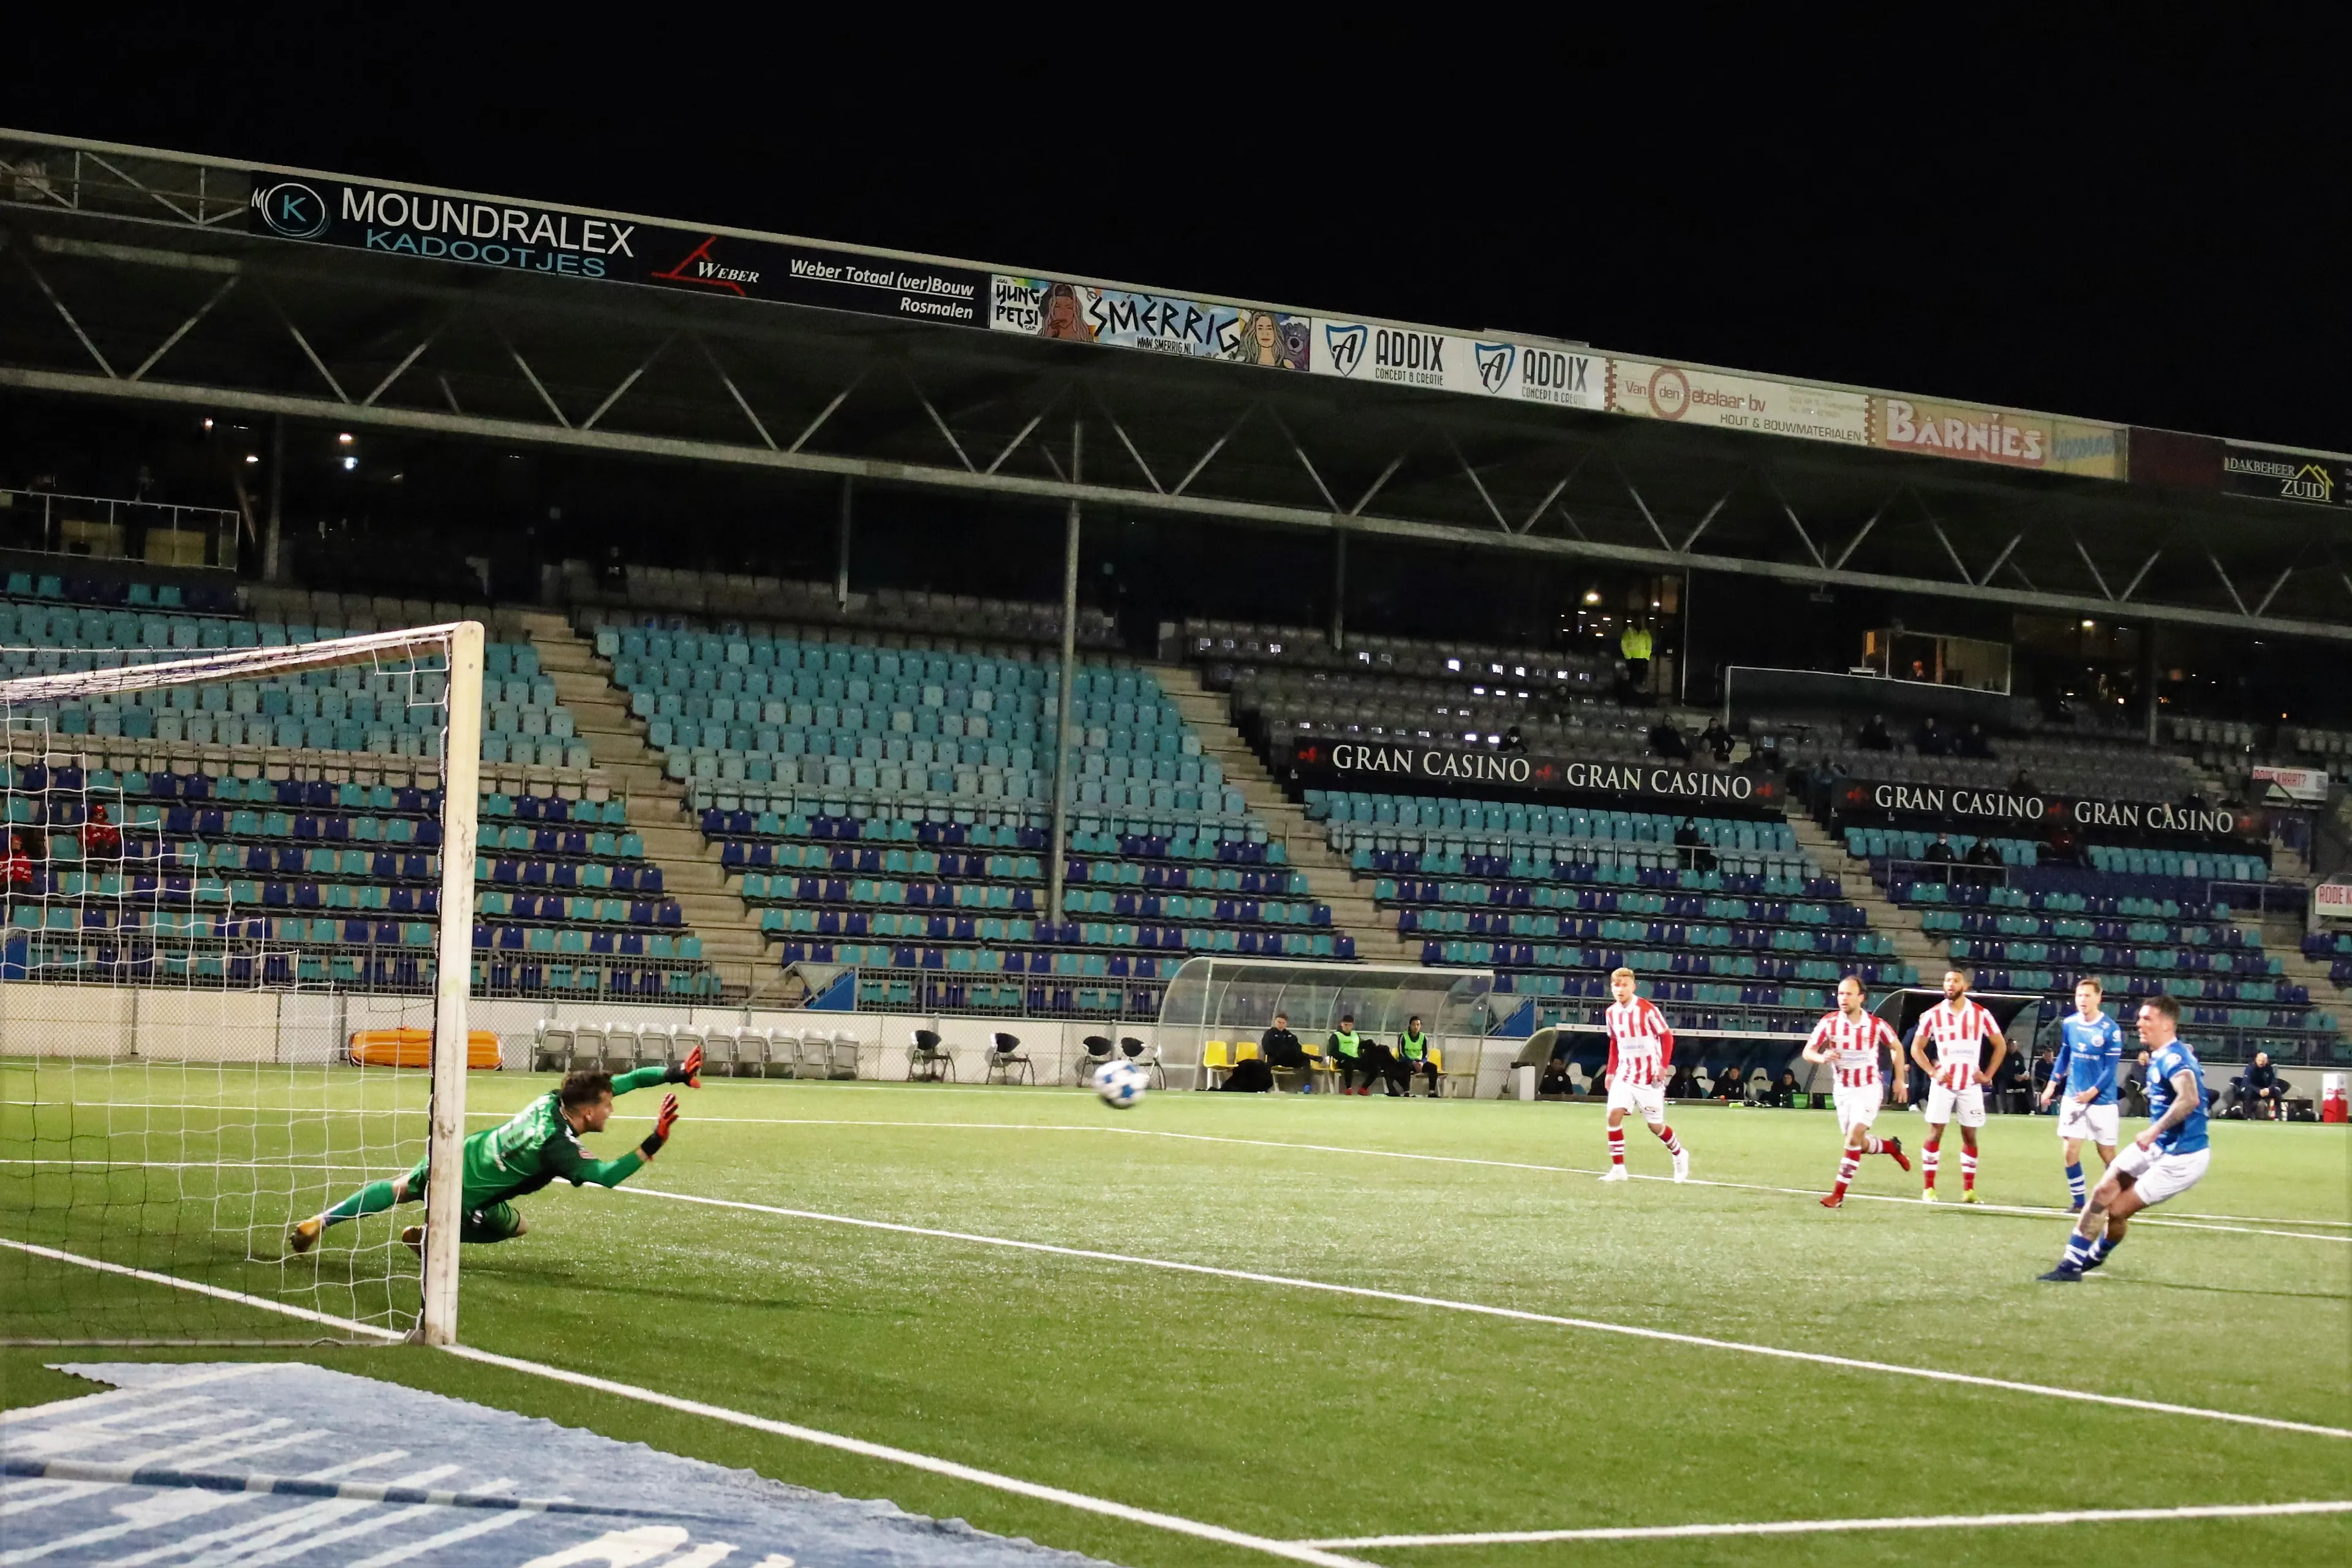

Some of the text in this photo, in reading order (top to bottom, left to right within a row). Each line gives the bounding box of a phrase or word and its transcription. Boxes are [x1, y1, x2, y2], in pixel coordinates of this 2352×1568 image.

[283, 195, 306, 222] K
[342, 187, 635, 258] MOUNDRALEX
[367, 228, 606, 278] KADOOTJES
[698, 261, 760, 284] WEBER
[790, 258, 974, 297] Weber Totaal (ver)Bouw
[900, 297, 973, 320] Rosmalen
[996, 284, 1040, 306] YUNG
[996, 305, 1038, 329] PETSI
[1137, 336, 1193, 355] WWW.SMERRIG.NL
[1376, 329, 1444, 372] ADDIX
[1375, 367, 1406, 382] CONCEPT
[1416, 372, 1444, 386] CREATIE
[1522, 349, 1589, 393] ADDIX
[1521, 386, 1551, 401] CONCEPT
[1625, 380, 1646, 396] Van
[1659, 385, 1679, 401] den
[1749, 394, 1766, 412] bv
[1720, 413, 1862, 442] HOUT & BOUWMATERIALEN
[1887, 399, 2043, 460] BARNIES
[2230, 458, 2296, 477] DAKBEHEER
[2281, 479, 2325, 499] ZUID
[1332, 744, 1530, 782] GRAN CASINO
[1567, 763, 1752, 799] GRAN CASINO
[1875, 785, 2044, 820] GRAN CASINO
[2075, 801, 2233, 833] GRAN CASINO
[2319, 886, 2343, 905] RODE
